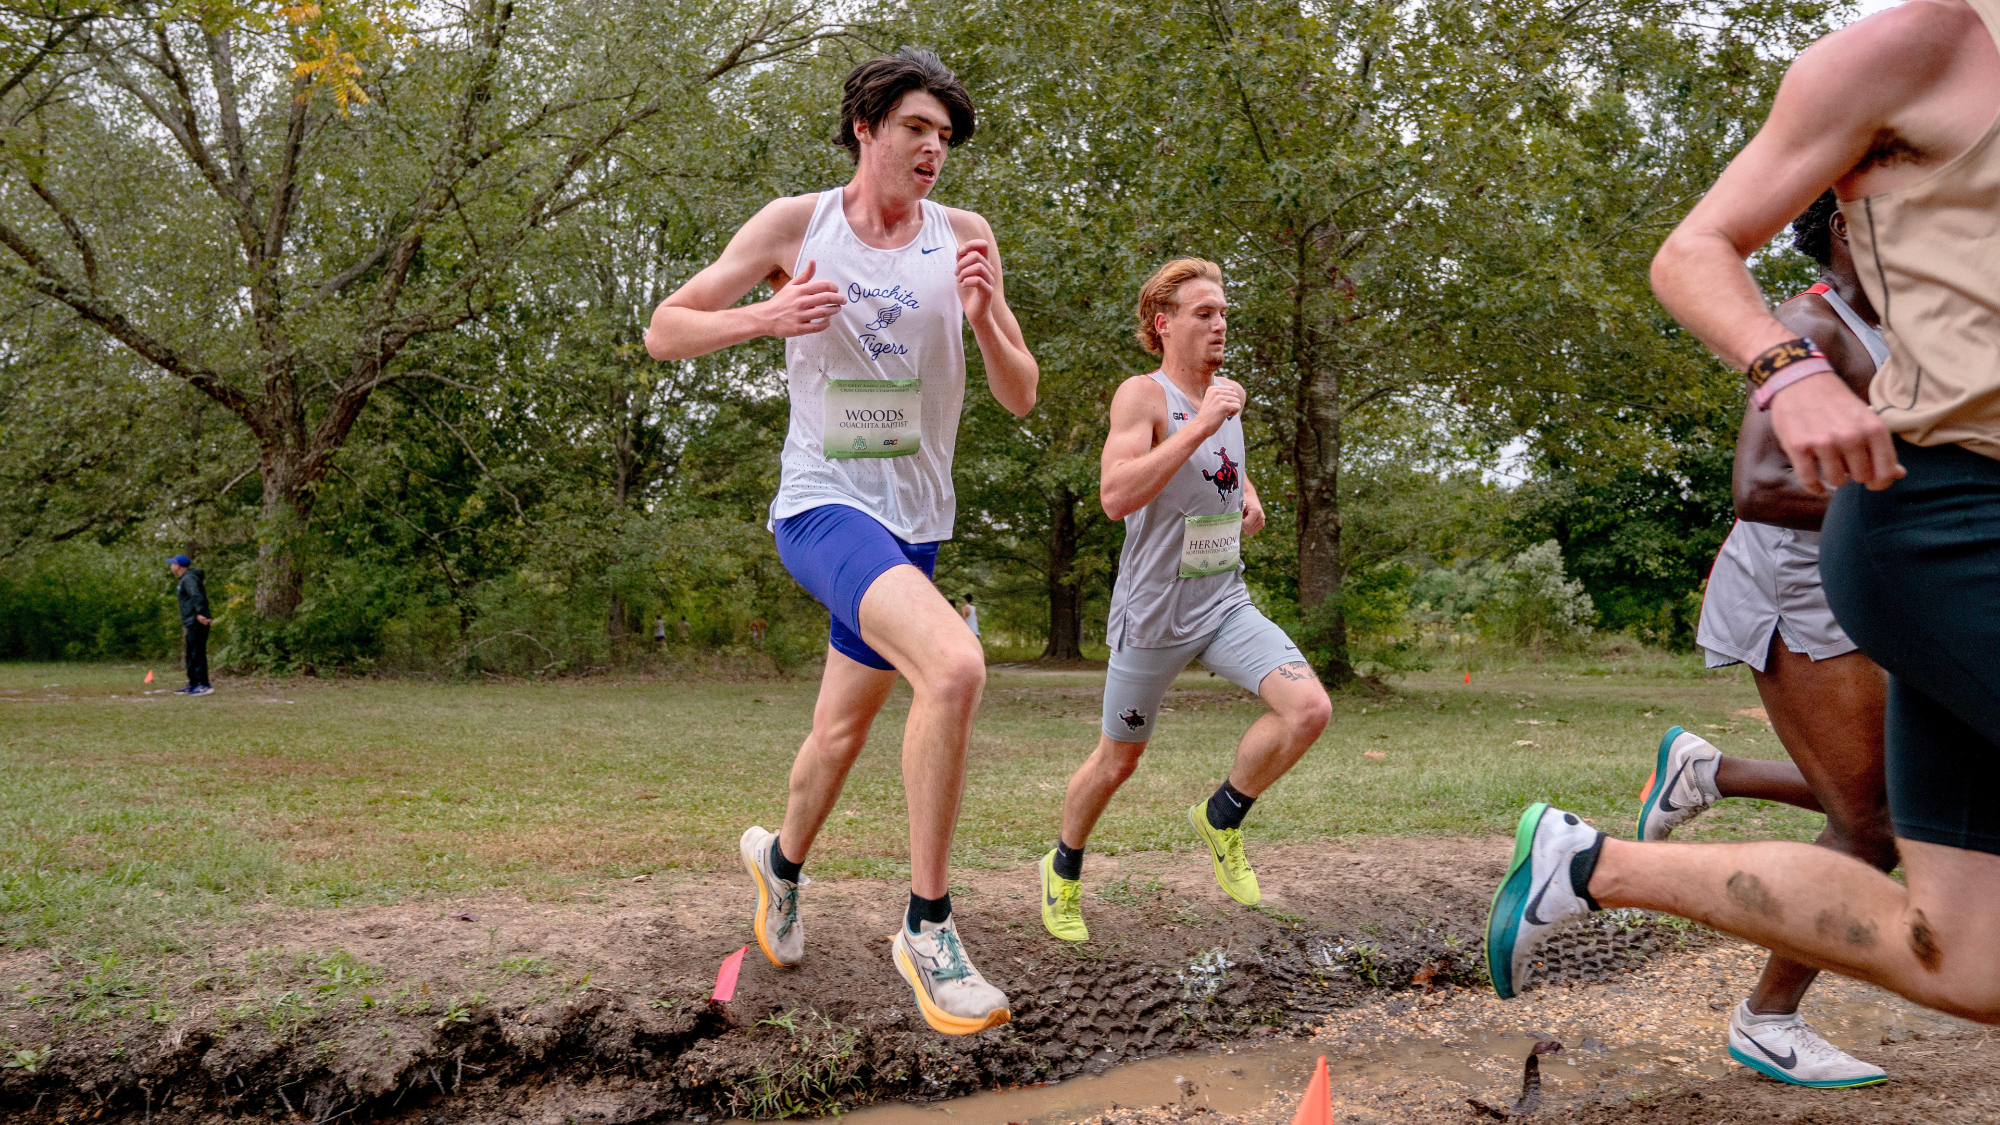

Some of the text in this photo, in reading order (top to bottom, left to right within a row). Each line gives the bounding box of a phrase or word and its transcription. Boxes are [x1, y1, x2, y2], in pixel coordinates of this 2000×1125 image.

[847, 282, 920, 309] Ouachita
[858, 333, 908, 361] Tigers
[1766, 344, 1808, 368] 24
[845, 408, 904, 422] WOODS
[1172, 412, 1189, 421] GAC
[839, 420, 909, 429] OUACHITA BAPTIST
[1189, 535, 1237, 550] HERNDON
